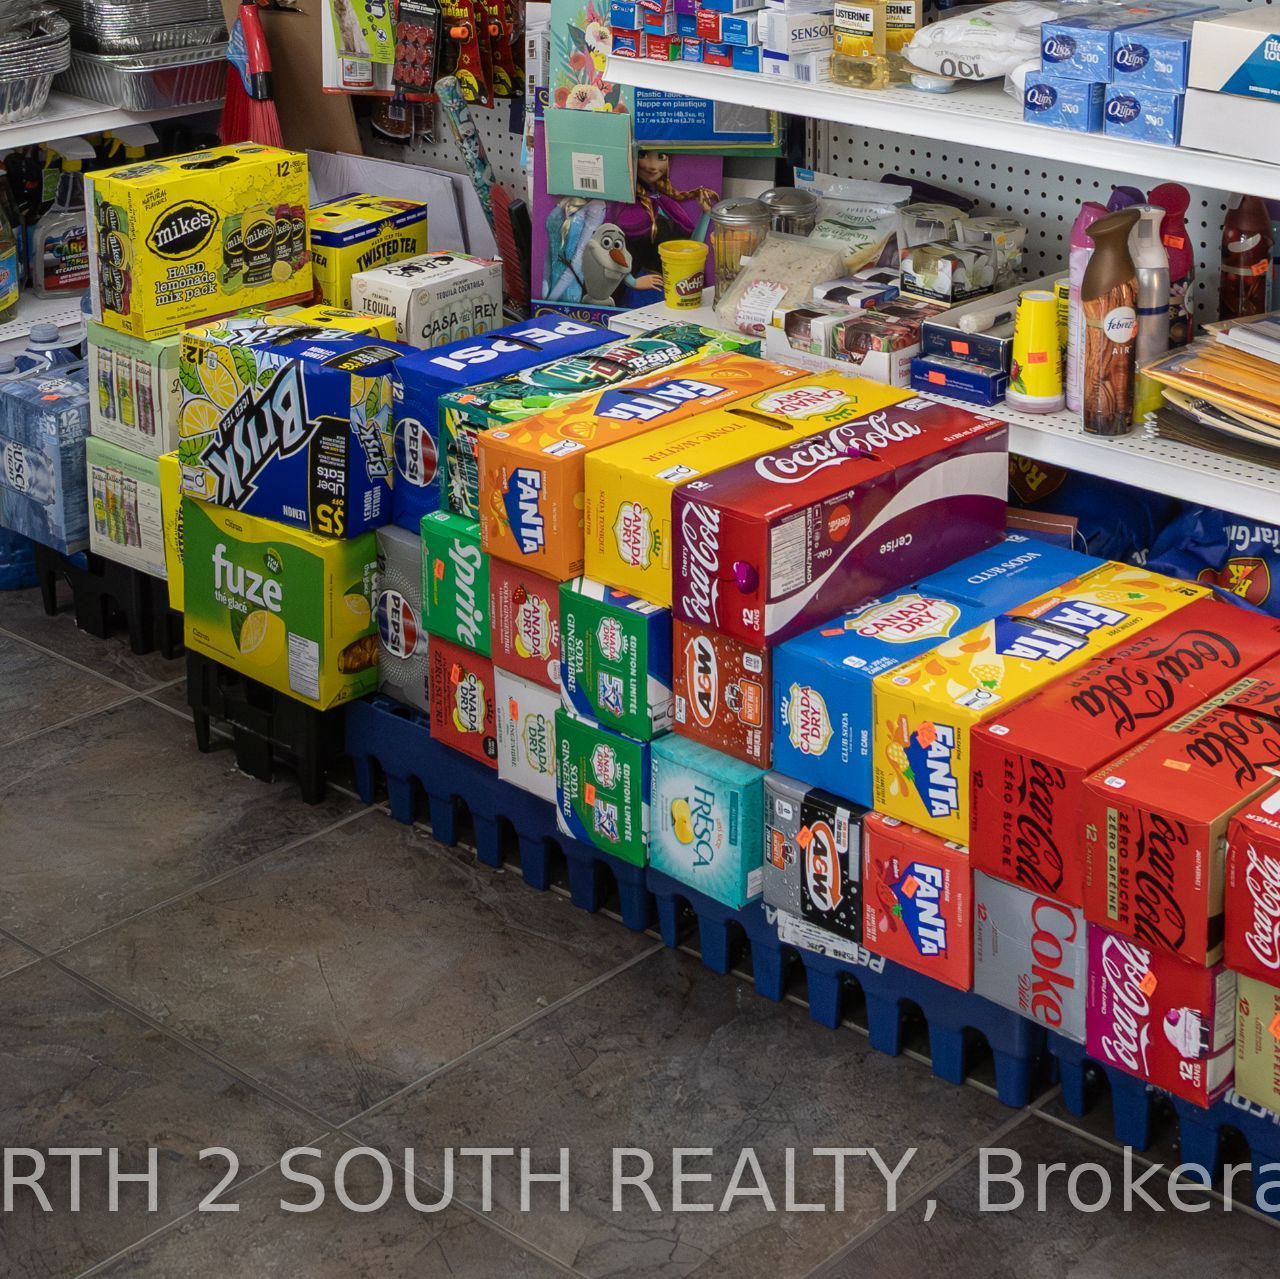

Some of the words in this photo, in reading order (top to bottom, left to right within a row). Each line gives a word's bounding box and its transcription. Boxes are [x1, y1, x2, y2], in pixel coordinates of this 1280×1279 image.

[835, 7, 870, 23] LISTERINE
[156, 214, 213, 250] mike's
[247, 227, 275, 248] mike's
[167, 262, 206, 280] HARD
[357, 244, 396, 270] TWISTED
[398, 240, 417, 254] TEA
[155, 269, 217, 295] lemonade
[156, 290, 182, 306] mix
[184, 283, 217, 304] pack
[436, 287, 460, 300] TEQUILA
[421, 312, 459, 338] CASA
[474, 303, 499, 322] REY
[1112, 347, 1131, 355] AIR
[643, 438, 699, 463] WATER
[701, 422, 746, 446] TONIC
[755, 412, 920, 485] Coca-Cola
[406, 421, 420, 484] PEPSI
[317, 467, 345, 482] Eats
[317, 480, 345, 495] Uber
[318, 509, 345, 536] $5
[517, 468, 547, 554] FANTA
[681, 545, 689, 577] Cherry
[879, 533, 912, 555] Cerise
[212, 544, 283, 613] fuze
[682, 502, 719, 628] Coca-Cola
[967, 563, 1000, 585] CLUB
[1002, 551, 1041, 577] SODA
[449, 539, 482, 648] Sprite
[390, 595, 401, 654] PEPSI
[859, 597, 933, 636] CANADA
[896, 610, 935, 634] DRY
[567, 613, 576, 693] GINGEMBRE
[575, 638, 583, 674] SODA
[801, 687, 810, 754] CANADA
[810, 711, 819, 744] DRY
[927, 723, 955, 818] FANTA
[693, 785, 714, 867] FRESCA
[1135, 809, 1188, 956] Coca-Cola
[1031, 895, 1078, 1026] Coke
